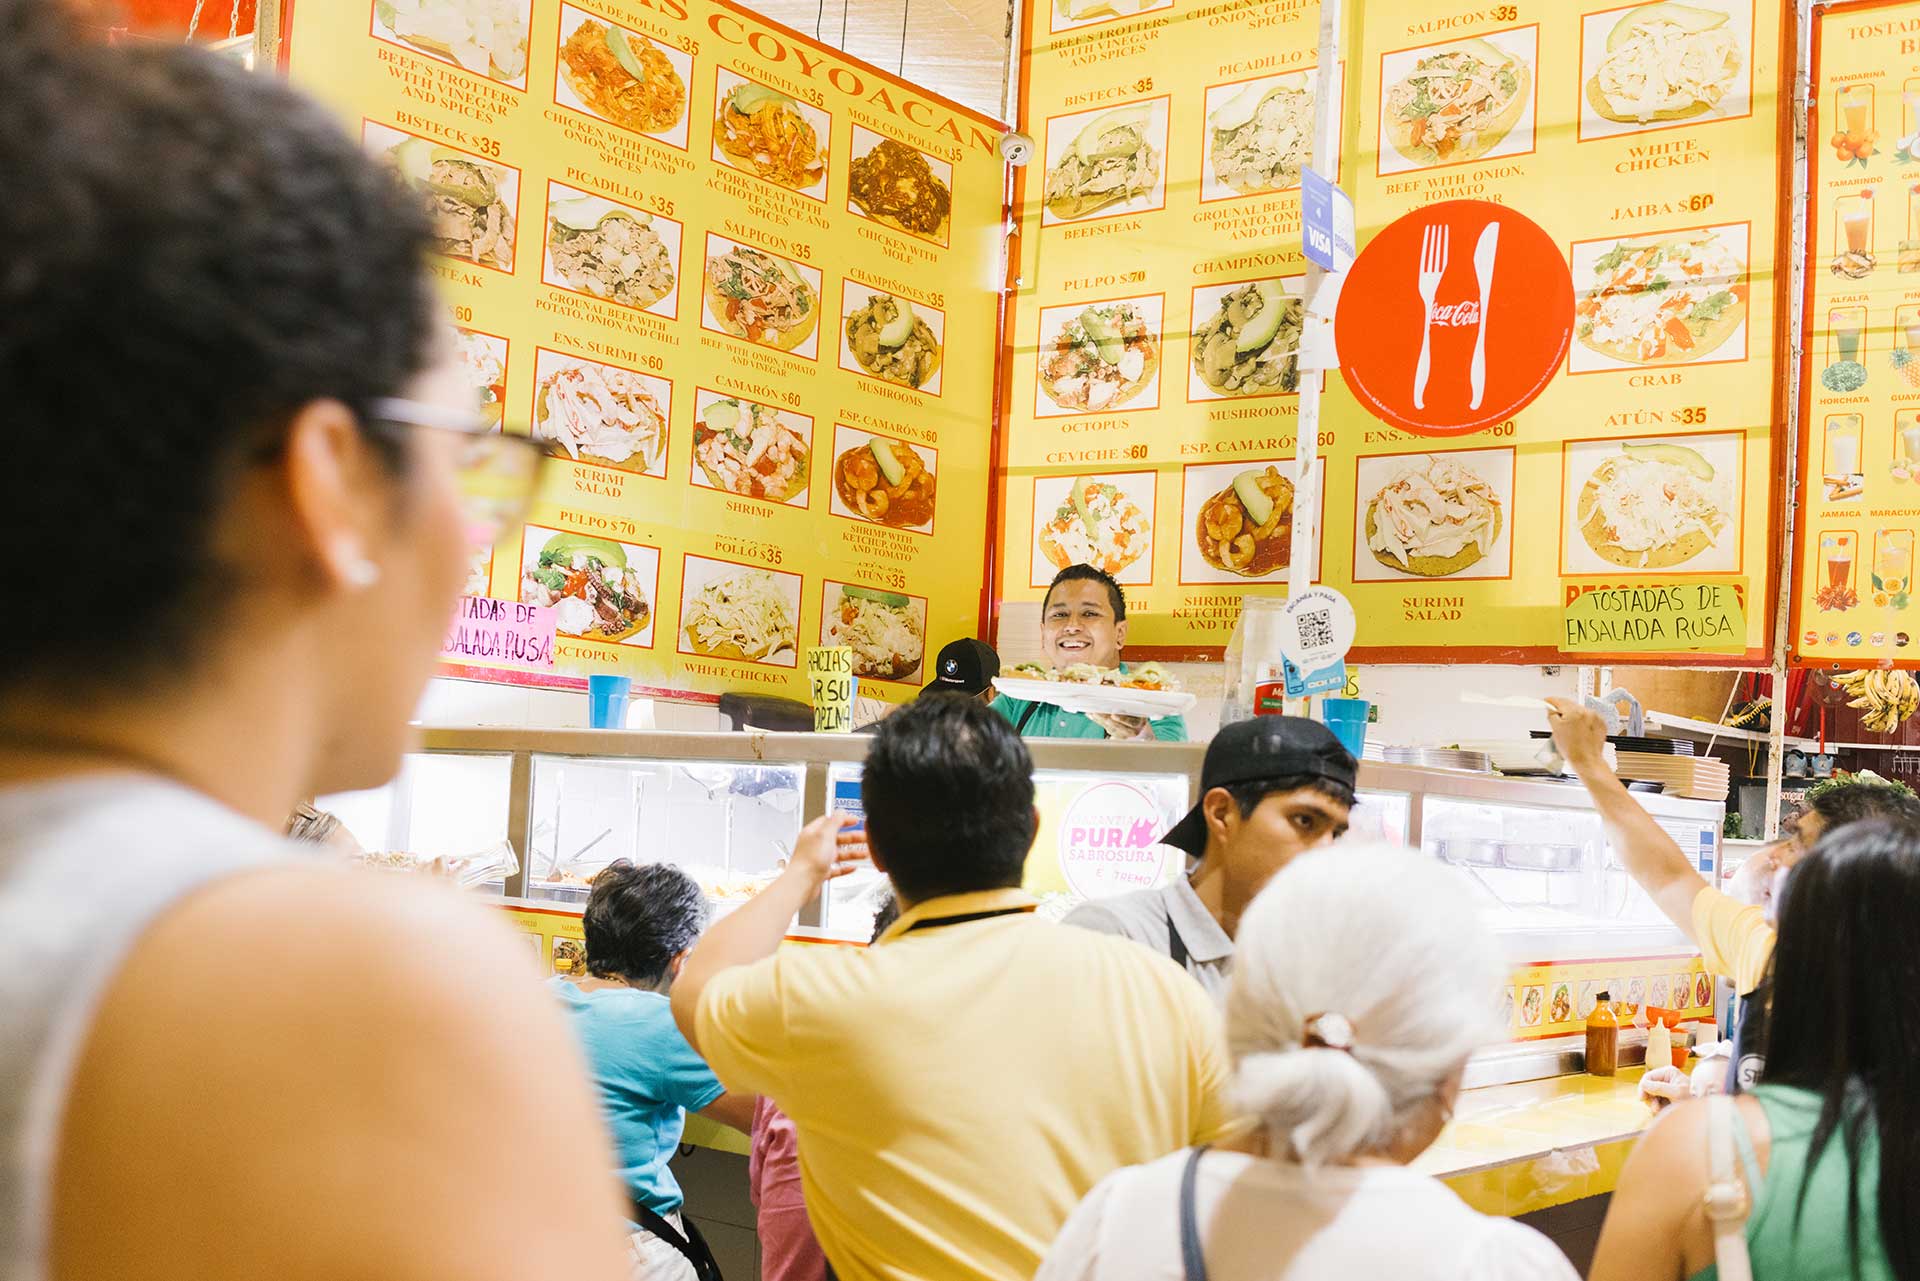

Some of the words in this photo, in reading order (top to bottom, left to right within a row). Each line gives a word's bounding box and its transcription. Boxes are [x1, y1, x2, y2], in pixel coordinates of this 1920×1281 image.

[607, 6, 623, 20] DE
[626, 13, 668, 37] POLLO
[676, 34, 699, 56] $35
[1098, 17, 1170, 42] TROTTERS
[1248, 12, 1300, 31] SPICES
[1407, 12, 1485, 37] SALPICON
[1490, 6, 1518, 22] $35
[1058, 42, 1095, 59] WITH
[1098, 30, 1160, 51] VINEGAR
[1070, 54, 1097, 67] AND
[1099, 44, 1147, 61] SPICES
[1219, 50, 1302, 77] PICADILLO
[708, 14, 999, 157] COYOACAN
[1830, 70, 1886, 83] MANDARINA
[388, 65, 433, 89] WITH
[436, 80, 508, 117] VINEGAR
[437, 68, 519, 108] TROTTERS
[1064, 84, 1128, 107] BISTECK
[402, 85, 436, 108] AND
[438, 98, 494, 124] SPICES
[396, 110, 467, 144] BISTECK
[471, 136, 501, 158] $35
[543, 110, 604, 138] CHICKEN
[607, 131, 642, 153] WITH
[643, 142, 696, 172] TOMATO
[848, 107, 881, 132] MOLE
[882, 122, 904, 138] CON
[907, 132, 942, 154] POLLO
[943, 147, 963, 163] $35
[1628, 138, 1698, 158] WHITE
[599, 153, 642, 175] SPICES
[613, 146, 651, 167] CHILI
[651, 159, 676, 176] AND
[1614, 149, 1711, 175] CHICKEN
[567, 167, 644, 202] PICADILLO
[650, 196, 674, 217] $35
[715, 169, 749, 191] PORK
[753, 184, 787, 205] MEAT
[790, 195, 822, 216] WITH
[1386, 180, 1421, 195] BEEF
[1427, 174, 1465, 189] WITH
[1424, 183, 1485, 202] TOMATO
[1828, 176, 1883, 188] TAMARINDO
[705, 178, 761, 205] ACHIOTE
[764, 198, 803, 222] SAUCE
[807, 214, 830, 230] AND
[1193, 205, 1256, 223] GROUNAL
[1263, 200, 1299, 213] BEEF
[1610, 201, 1672, 221] JAIBA
[1677, 194, 1714, 213] $60
[747, 204, 790, 228] SPICES
[1274, 210, 1302, 224] ONI
[724, 219, 787, 251] SALPICON
[790, 243, 811, 260] $35
[1064, 220, 1142, 240] BEEFSTEAK
[1231, 229, 1257, 241] AND
[1261, 223, 1301, 239] CHILI
[1308, 224, 1331, 257] VISA
[857, 226, 907, 253] CHICKEN
[910, 245, 938, 263] WITH
[882, 247, 914, 265] MOLE
[1193, 252, 1305, 275] CHAMPIÑONES
[850, 267, 925, 300] CHAMPIÑONES
[927, 291, 944, 307] $35
[1064, 273, 1116, 291] PULPO
[1119, 271, 1145, 285] $70
[1830, 295, 1869, 304] ALFALFA
[586, 314, 622, 331] ONION
[624, 324, 647, 337] AND
[649, 332, 680, 346] CHILI
[607, 308, 635, 323] BEEF
[638, 316, 666, 332] WITH
[553, 332, 584, 350] ENS.
[587, 341, 637, 363] SURIMI
[641, 354, 663, 370] $60
[700, 337, 721, 350] BEEF
[726, 343, 749, 357] WITH
[782, 360, 816, 377] TOMATO
[731, 356, 749, 368] AND
[750, 360, 787, 378] VINEGAR
[715, 375, 778, 401] CAMARÓN
[781, 392, 801, 407] $60
[1628, 373, 1682, 389] CRAB
[857, 380, 923, 408] MUSHROOMS
[1819, 396, 1870, 405] HORCHATA
[1209, 406, 1299, 422] MUSHROOMS
[1604, 408, 1663, 427] ATÚN
[1670, 407, 1707, 425] $35
[839, 409, 861, 425] ESP.
[863, 415, 918, 439] CAMARÓN
[921, 430, 937, 443] $60
[1062, 419, 1129, 434] OCTOPUS
[1364, 430, 1402, 443] ENS.
[1046, 448, 1120, 463] CEVICHE
[1123, 444, 1148, 459] $60
[1181, 442, 1211, 456] ESP.
[573, 467, 625, 486] SURIMI
[575, 481, 622, 498] SALAD
[726, 500, 774, 518] SHRIMP
[1819, 510, 1862, 518] JAMAICA
[560, 511, 606, 529] PULPO
[611, 521, 636, 536] $70
[850, 525, 885, 543] SHRIMP
[887, 531, 912, 544] WITH
[760, 549, 782, 565] $35
[851, 546, 870, 554] AND
[872, 548, 911, 562] TOMATO
[889, 542, 919, 555] ONION
[886, 571, 905, 588] $35
[1184, 596, 1242, 606] SHRIMP
[1402, 597, 1465, 609] SURIMI
[1589, 587, 1684, 613] TOSTADAS
[1697, 585, 1721, 611] DE
[516, 604, 536, 624] DE
[1187, 620, 1217, 630] AND
[1404, 609, 1462, 621] SALAD
[1567, 618, 1665, 646] ENSALADA
[1676, 614, 1734, 640] RUSA
[684, 663, 728, 679] WHITE
[731, 668, 789, 684] CHICKEN
[1071, 827, 1148, 848] PURA
[1069, 850, 1155, 863] SABROSURA
